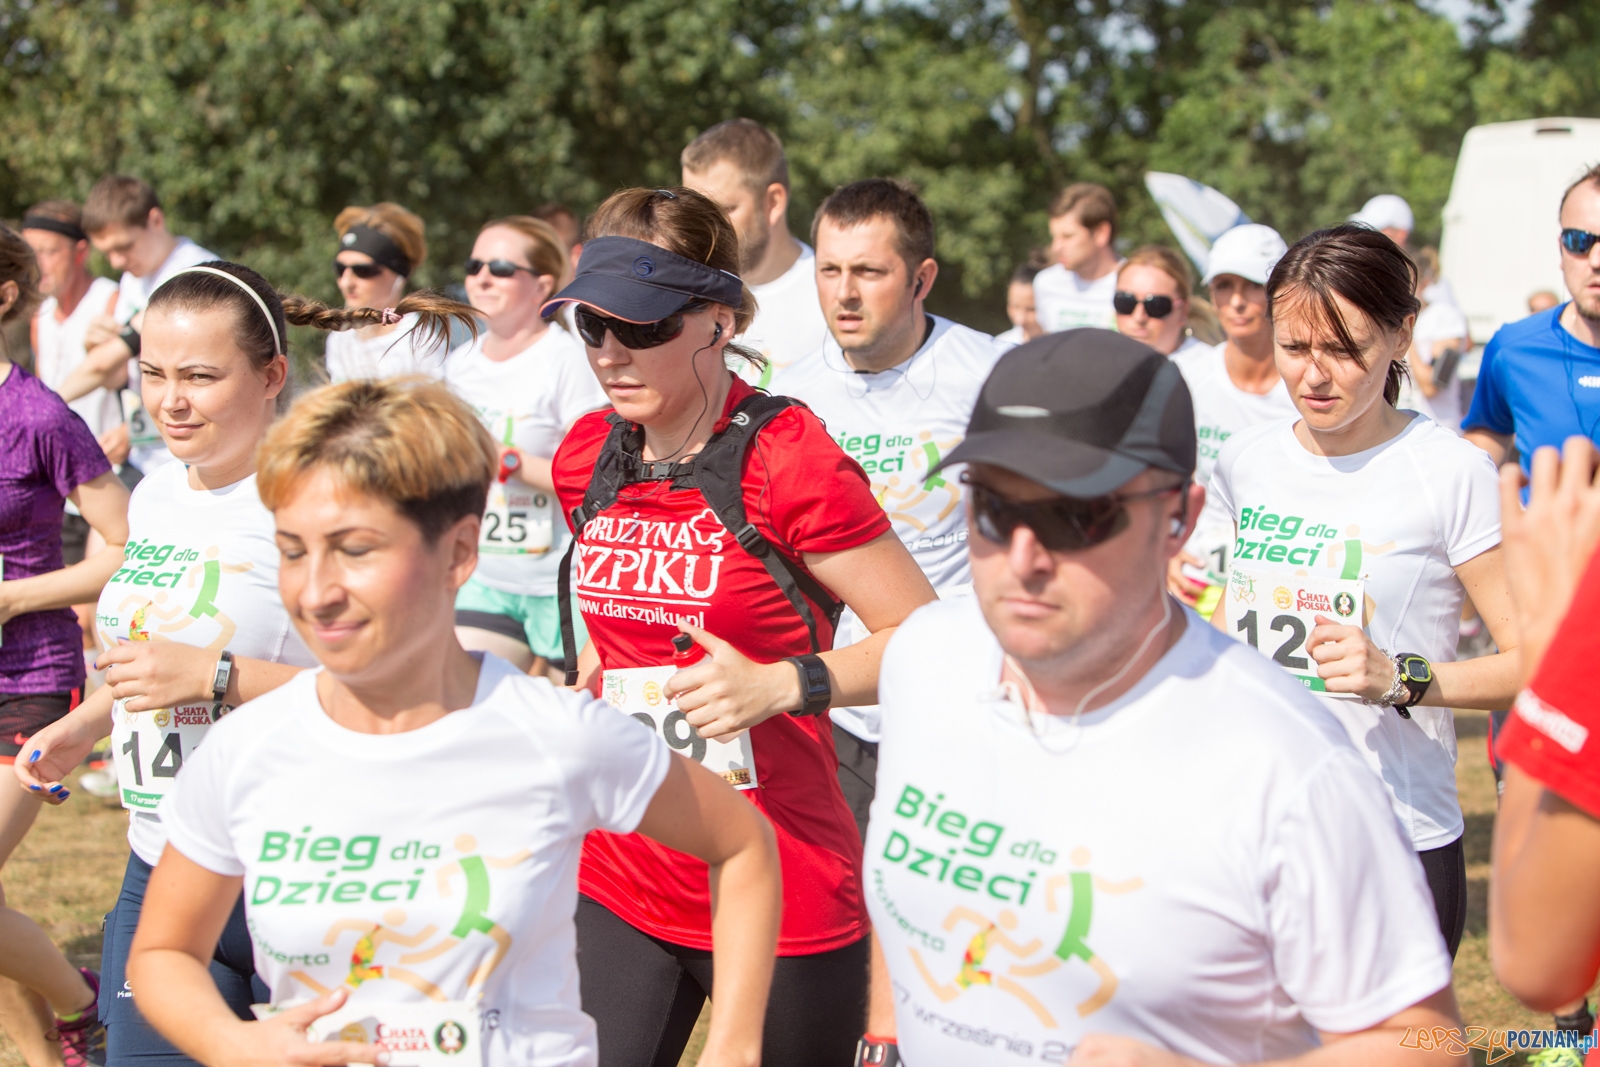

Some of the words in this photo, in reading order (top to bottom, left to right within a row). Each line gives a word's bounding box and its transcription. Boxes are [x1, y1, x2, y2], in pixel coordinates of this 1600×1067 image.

[834, 431, 881, 455] ieg
[886, 435, 913, 447] dla
[855, 451, 905, 474] eci
[485, 512, 527, 542] 25
[1240, 505, 1304, 540] Bieg
[1305, 523, 1338, 539] dla
[124, 538, 176, 567] Bieg
[173, 548, 200, 562] dla
[917, 531, 968, 549] 2016
[1233, 537, 1324, 567] Dzieci
[110, 564, 187, 589] zieci
[1297, 589, 1330, 603] CHATA
[1297, 599, 1333, 612] POLSKA
[1237, 609, 1309, 669] 12
[174, 706, 208, 716] CHATA
[174, 715, 212, 728] POLSKA
[122, 731, 199, 787] 14
[894, 784, 1004, 858] Bieg
[1010, 840, 1058, 865] dla
[257, 826, 381, 871] Bieg
[390, 841, 441, 860] dla
[882, 830, 1037, 906] Dzieci
[250, 868, 425, 906] Dzieci
